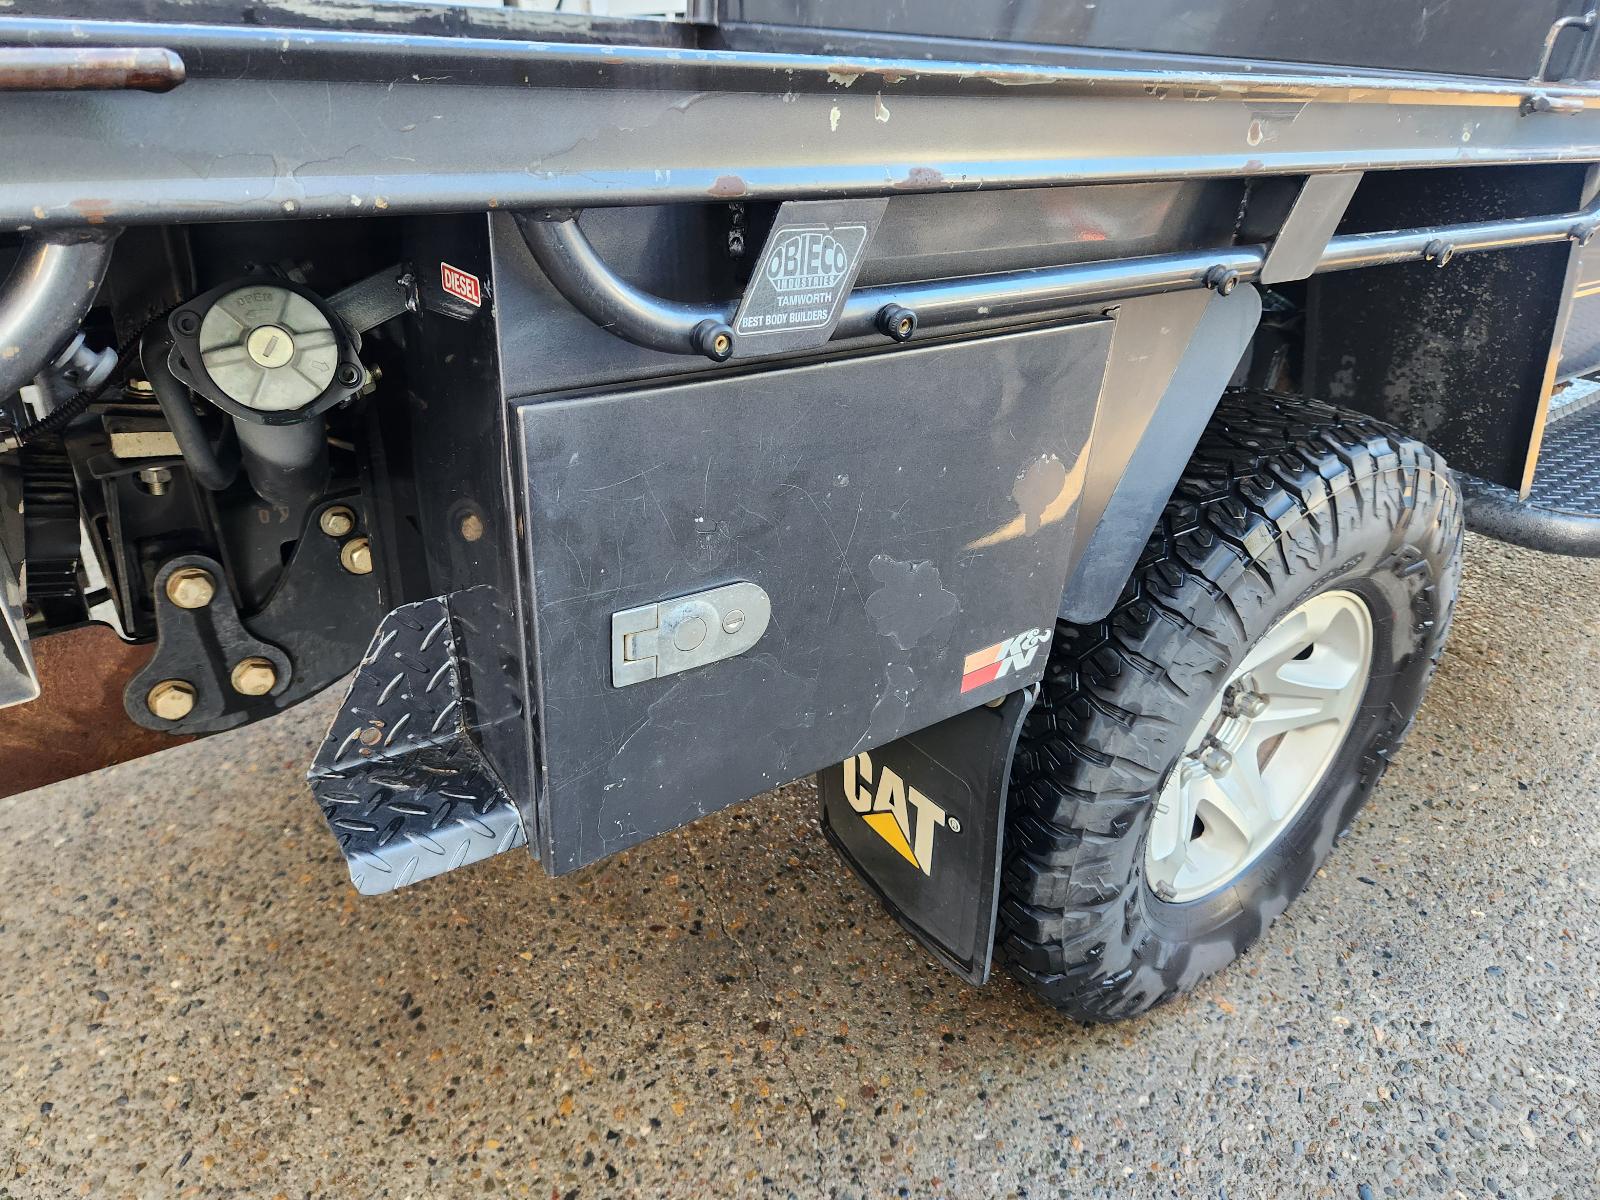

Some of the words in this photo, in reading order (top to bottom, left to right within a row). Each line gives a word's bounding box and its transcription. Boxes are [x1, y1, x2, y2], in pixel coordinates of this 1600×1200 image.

[767, 234, 847, 279] OBIECO
[445, 269, 479, 301] DIESEL
[777, 276, 835, 290] INDUSTRIES
[777, 292, 832, 307] TAMWORTH
[742, 315, 763, 328] BEST
[765, 313, 787, 325] BODY
[789, 310, 828, 323] BUILDERS
[995, 628, 1051, 680] K&N
[843, 751, 946, 877] CAT
